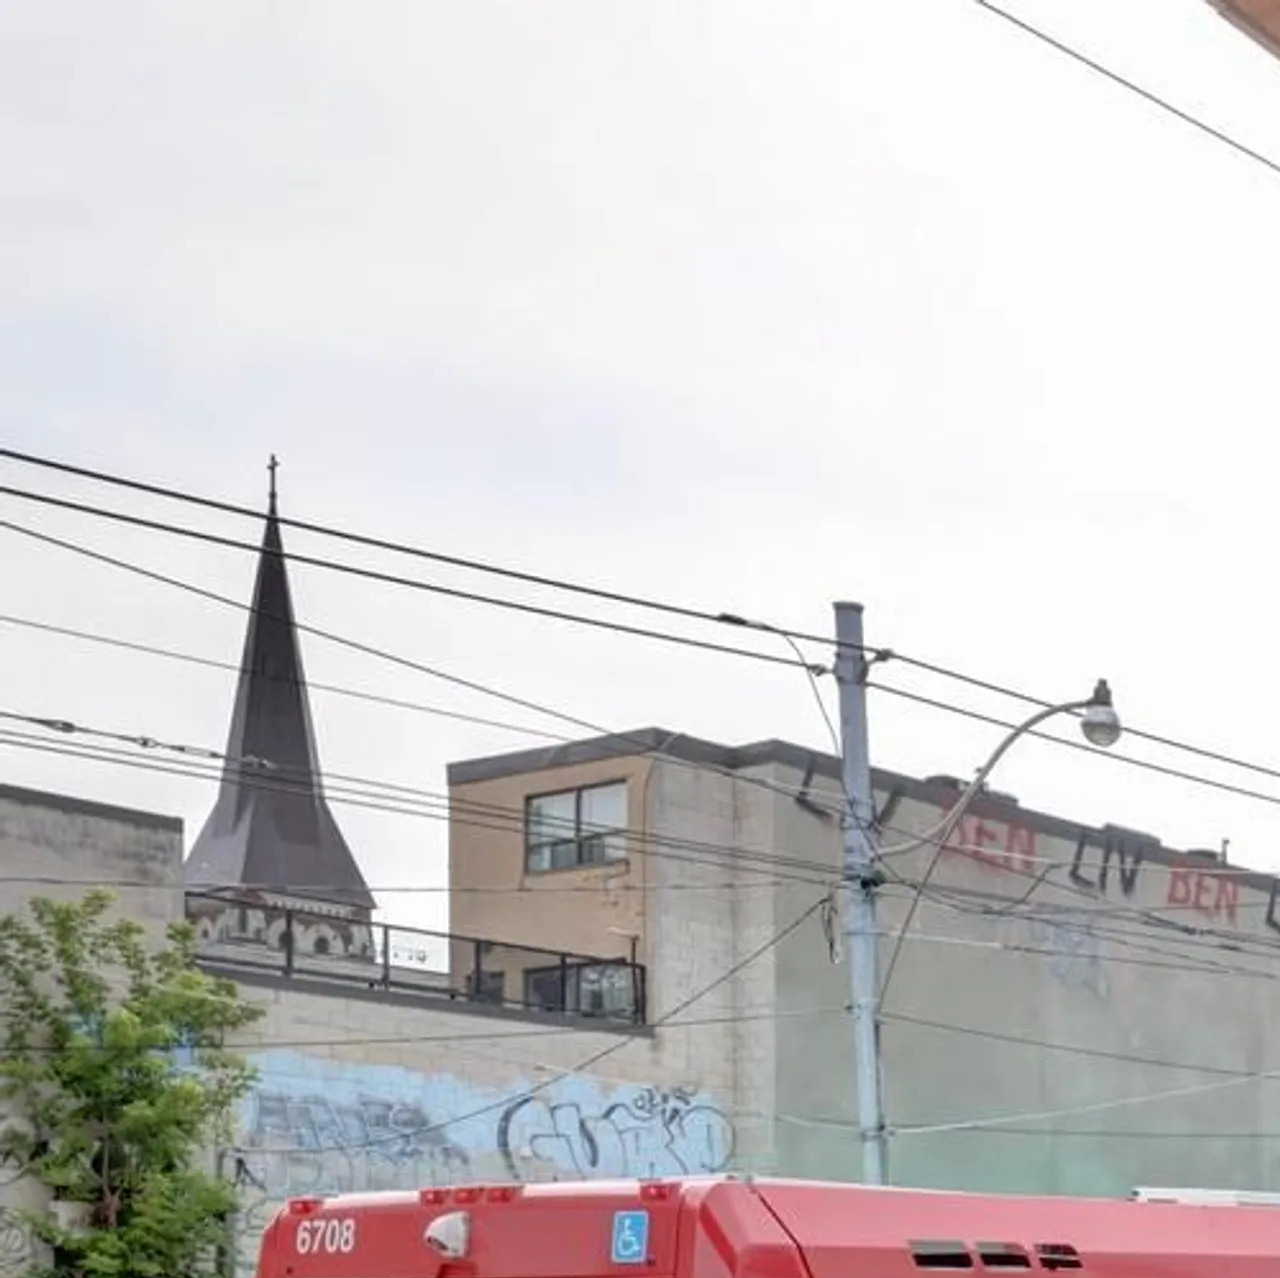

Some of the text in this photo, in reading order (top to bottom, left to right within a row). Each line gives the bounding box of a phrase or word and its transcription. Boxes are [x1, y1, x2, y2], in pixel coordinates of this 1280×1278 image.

[1070, 830, 1145, 896] LIV
[1165, 855, 1240, 930] BEN
[296, 1219, 355, 1254] 6708
